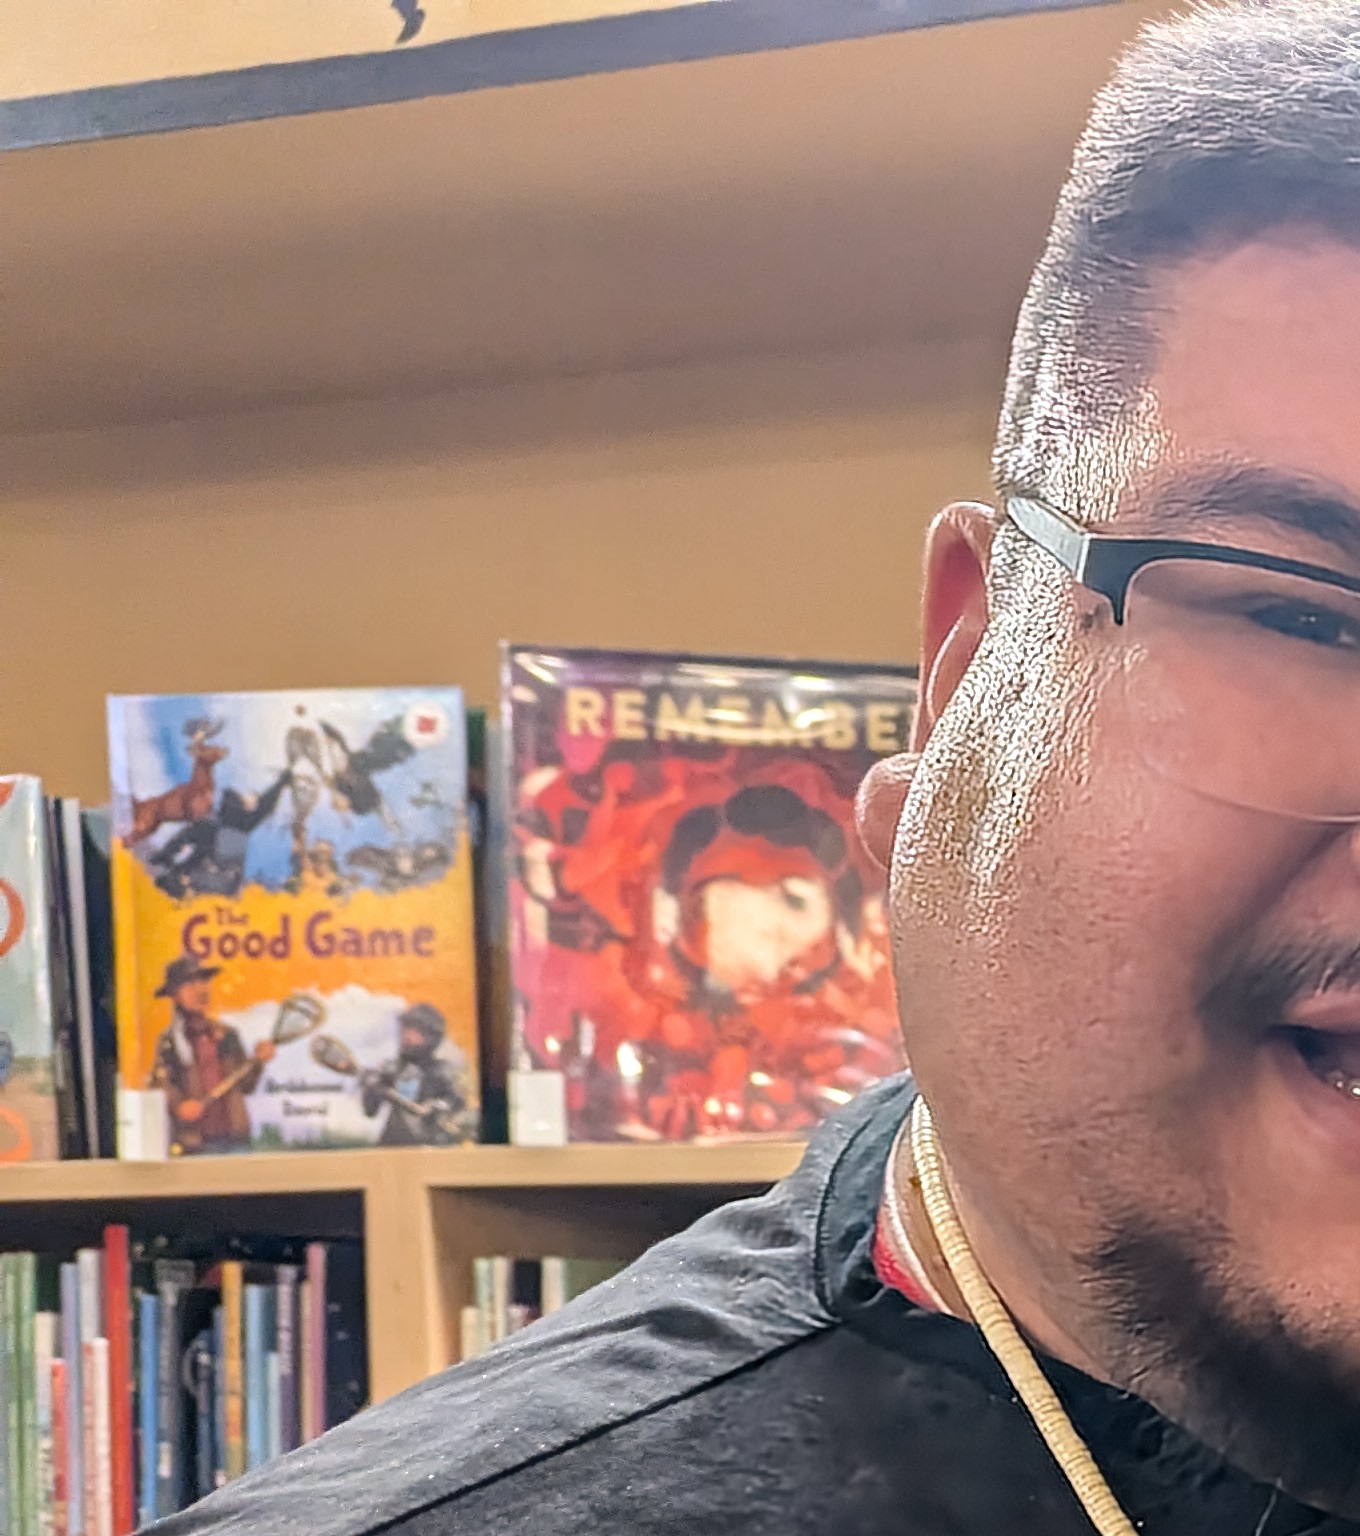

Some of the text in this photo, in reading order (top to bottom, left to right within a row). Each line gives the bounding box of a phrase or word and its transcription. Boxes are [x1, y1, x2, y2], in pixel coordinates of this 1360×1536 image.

[565, 686, 899, 752] REMEMBE
[182, 910, 434, 960] Good Game
